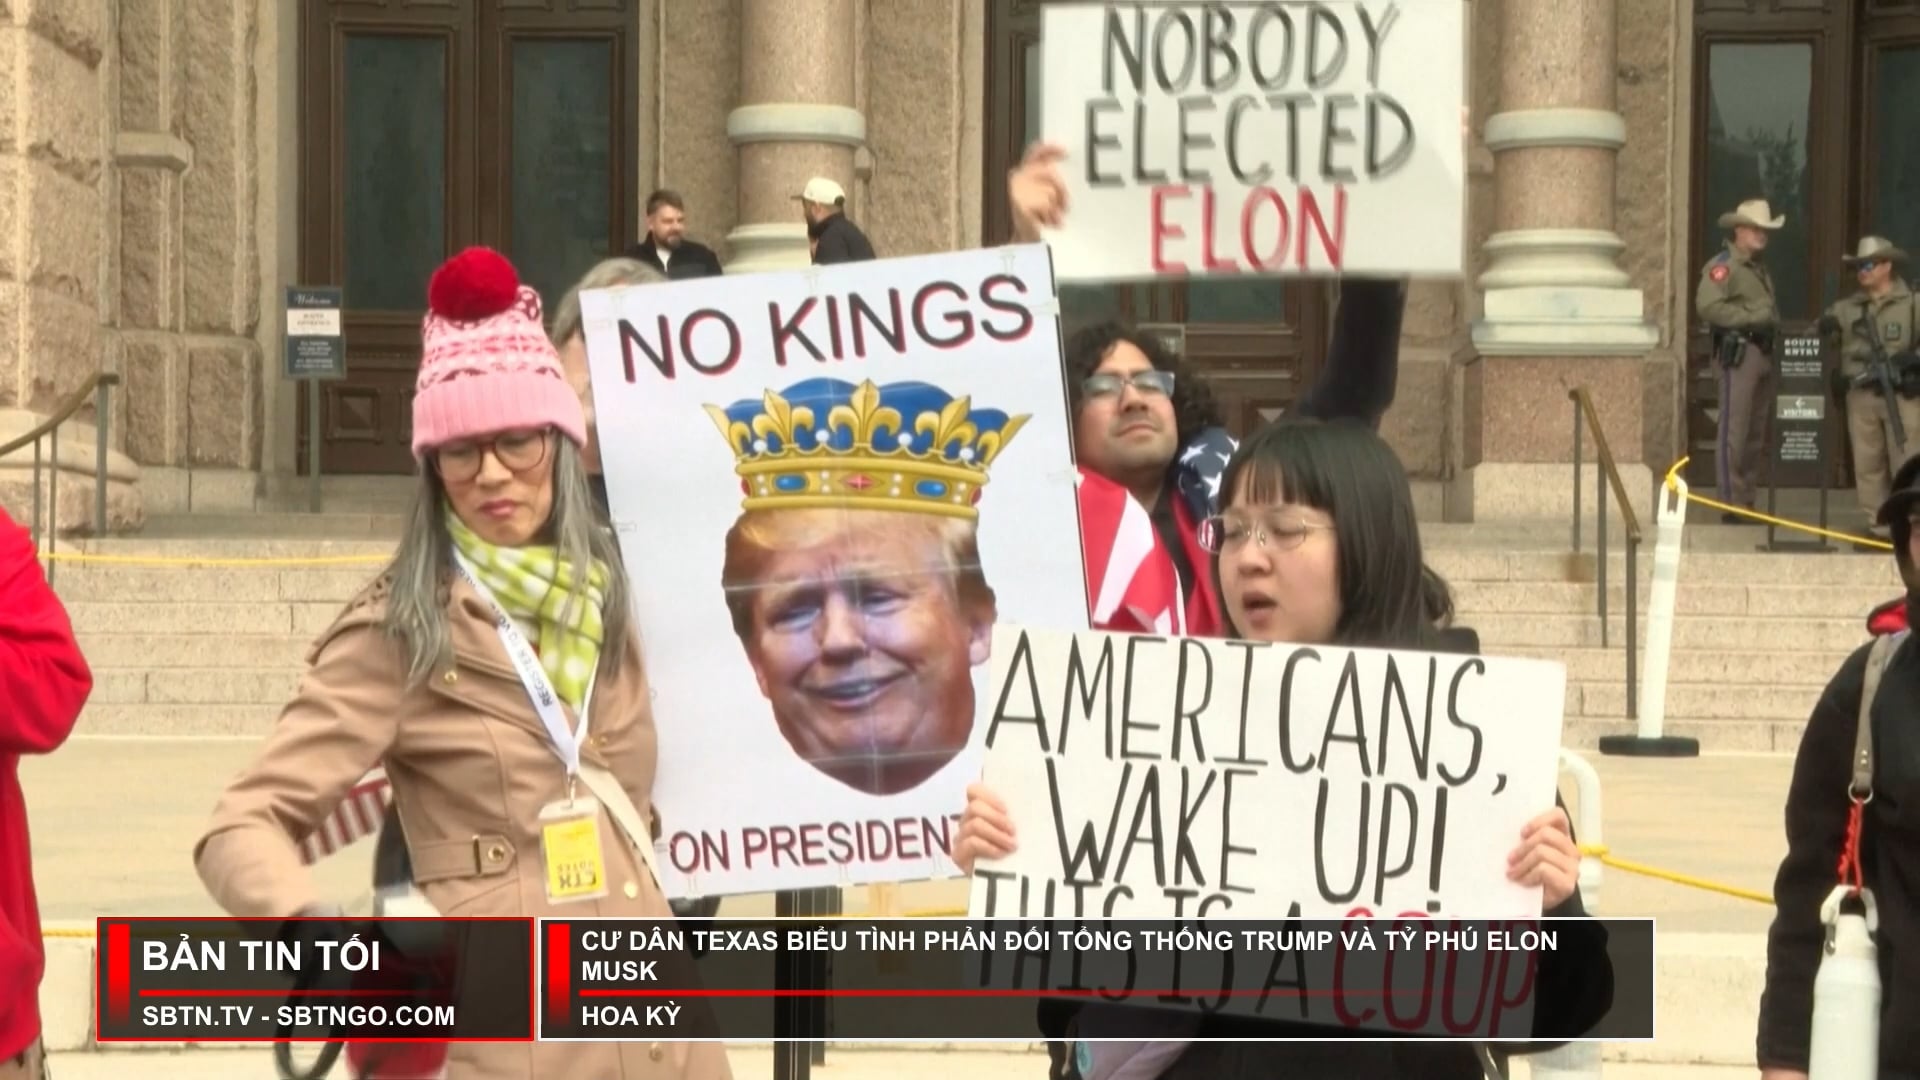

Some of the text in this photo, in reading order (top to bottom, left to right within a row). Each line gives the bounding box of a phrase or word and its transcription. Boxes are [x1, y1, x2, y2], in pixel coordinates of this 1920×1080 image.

[1102, 2, 1400, 95] NOBODY
[1085, 93, 1417, 187] ELECTED
[1150, 184, 1349, 273] ELON
[618, 274, 1034, 384] NO KINGS
[1784, 338, 1820, 347] SOUTH
[1784, 348, 1820, 357] ENTRY
[986, 630, 1508, 796] AMERICANS,
[670, 829, 730, 874] ON
[1045, 758, 1449, 912] WAKE UP!
[975, 869, 1540, 1038] THIS IS A COUP
